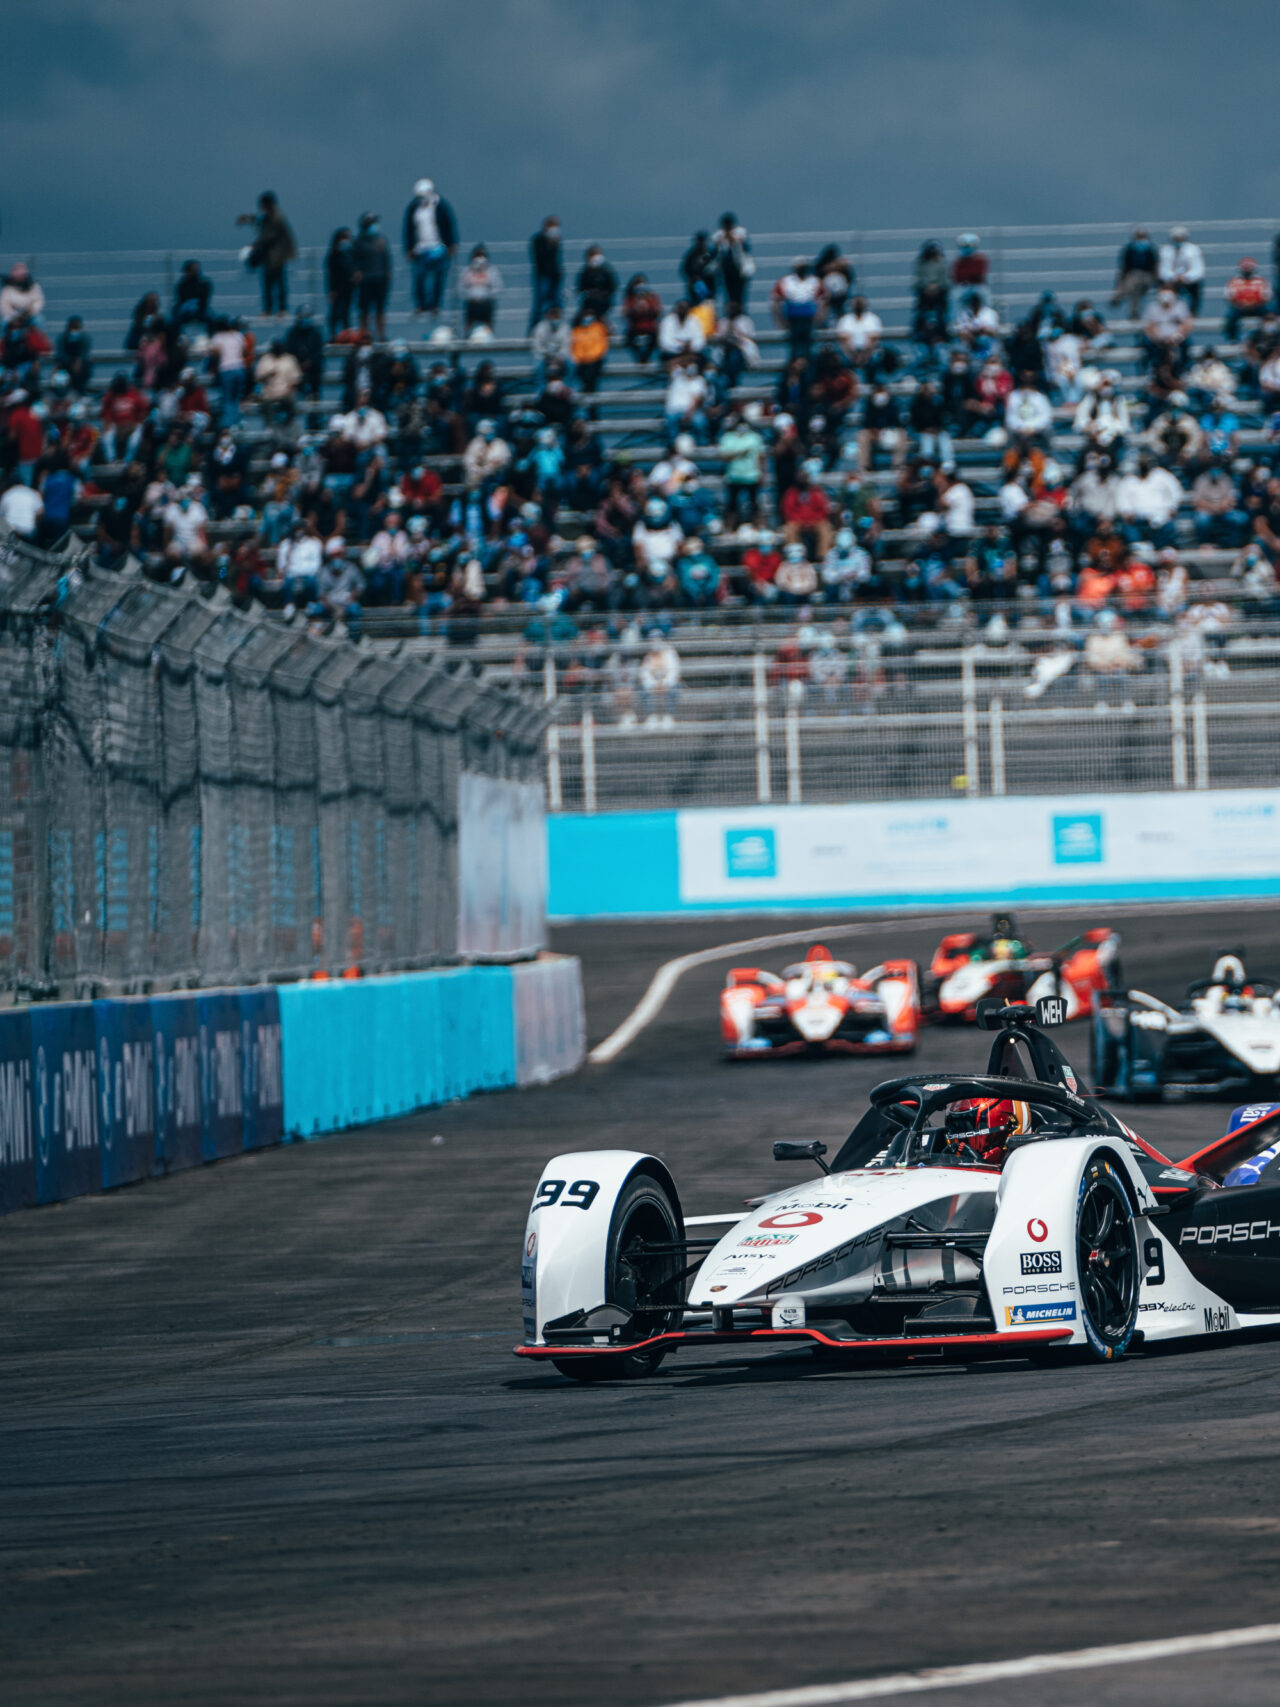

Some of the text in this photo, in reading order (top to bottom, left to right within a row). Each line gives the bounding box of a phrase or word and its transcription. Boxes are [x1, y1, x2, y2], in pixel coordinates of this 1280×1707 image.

[1041, 1000, 1063, 1024] WEH
[531, 1180, 601, 1214] 99
[776, 1202, 848, 1212] Mobil
[723, 1252, 776, 1261] Ansys
[766, 1225, 886, 1300] PORSCHE
[1022, 1252, 1060, 1269] BOSS
[1002, 1282, 1076, 1296] PORSCHE
[1026, 1307, 1073, 1319] MICHELIN
[1204, 1306, 1230, 1332] Mobil
